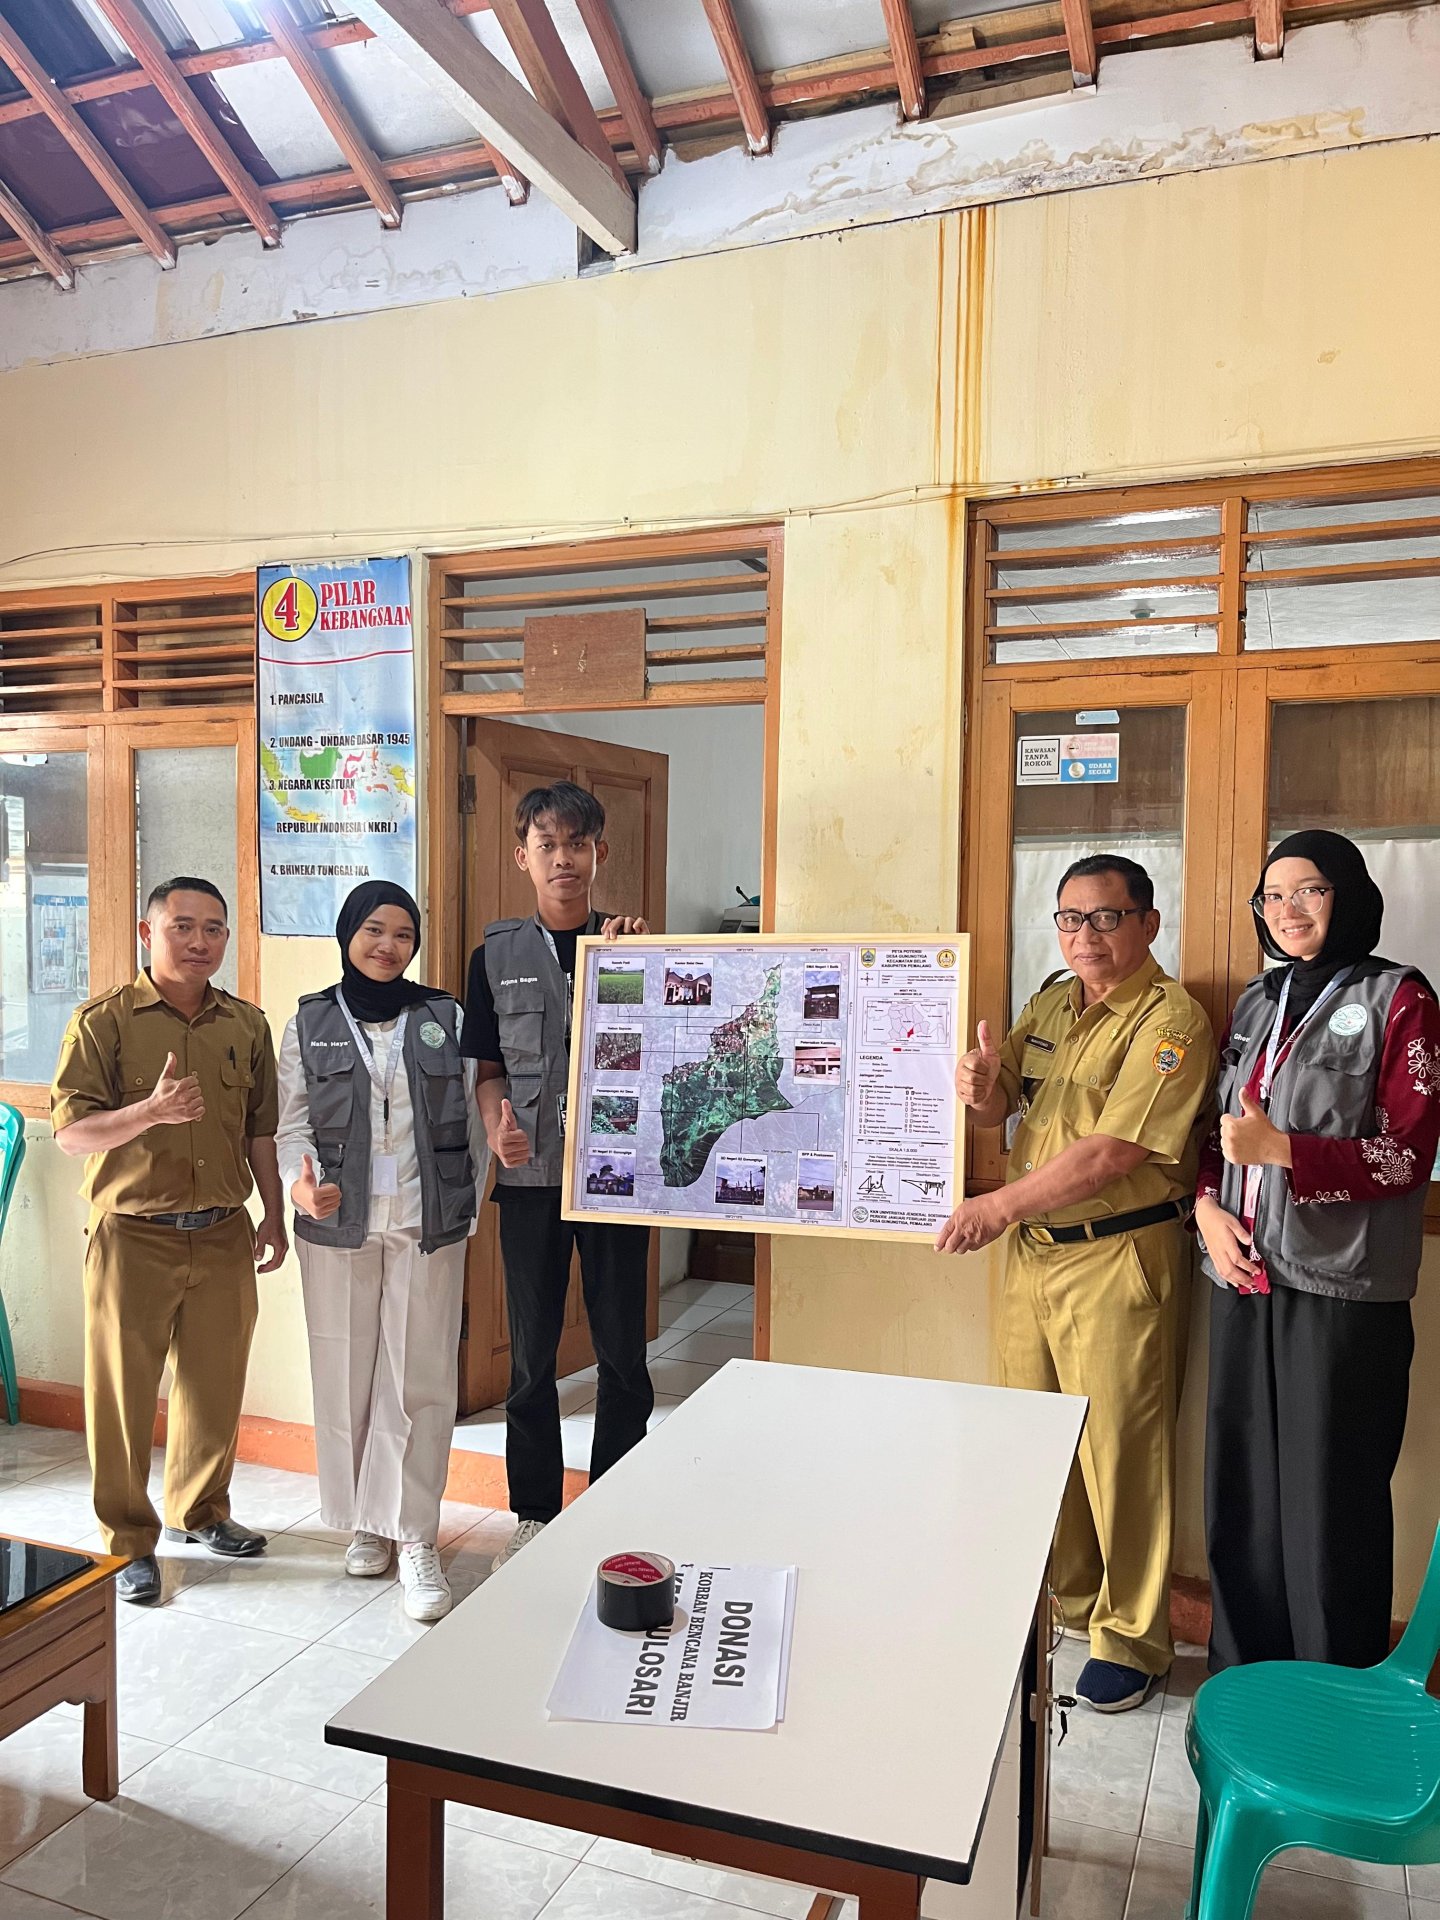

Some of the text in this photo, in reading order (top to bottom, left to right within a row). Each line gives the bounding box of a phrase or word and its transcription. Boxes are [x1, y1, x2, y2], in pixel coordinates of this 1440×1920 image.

[274, 580, 376, 631] 4 PILAR
[320, 605, 412, 631] KEBANGSAAN
[270, 692, 324, 706] 1. PANCASILA
[270, 738, 278, 748] 2.
[280, 736, 312, 748] UNDANG
[320, 734, 357, 746] UNDANG
[357, 734, 384, 745] DASAR
[386, 734, 410, 745] 1945
[270, 778, 355, 790] 3. NEGARA KESATUAN
[276, 822, 318, 832] REPUBLIK
[320, 822, 361, 832] INDONESIA
[270, 864, 278, 876] 4.
[280, 864, 315, 876] BHINEKA
[318, 865, 354, 876] TUNGGAL
[670, 1571, 714, 1722] KORBAN BENCANA BANJIR
[712, 1600, 753, 1687] DONASI
[625, 1624, 672, 1716] ULOSARI
